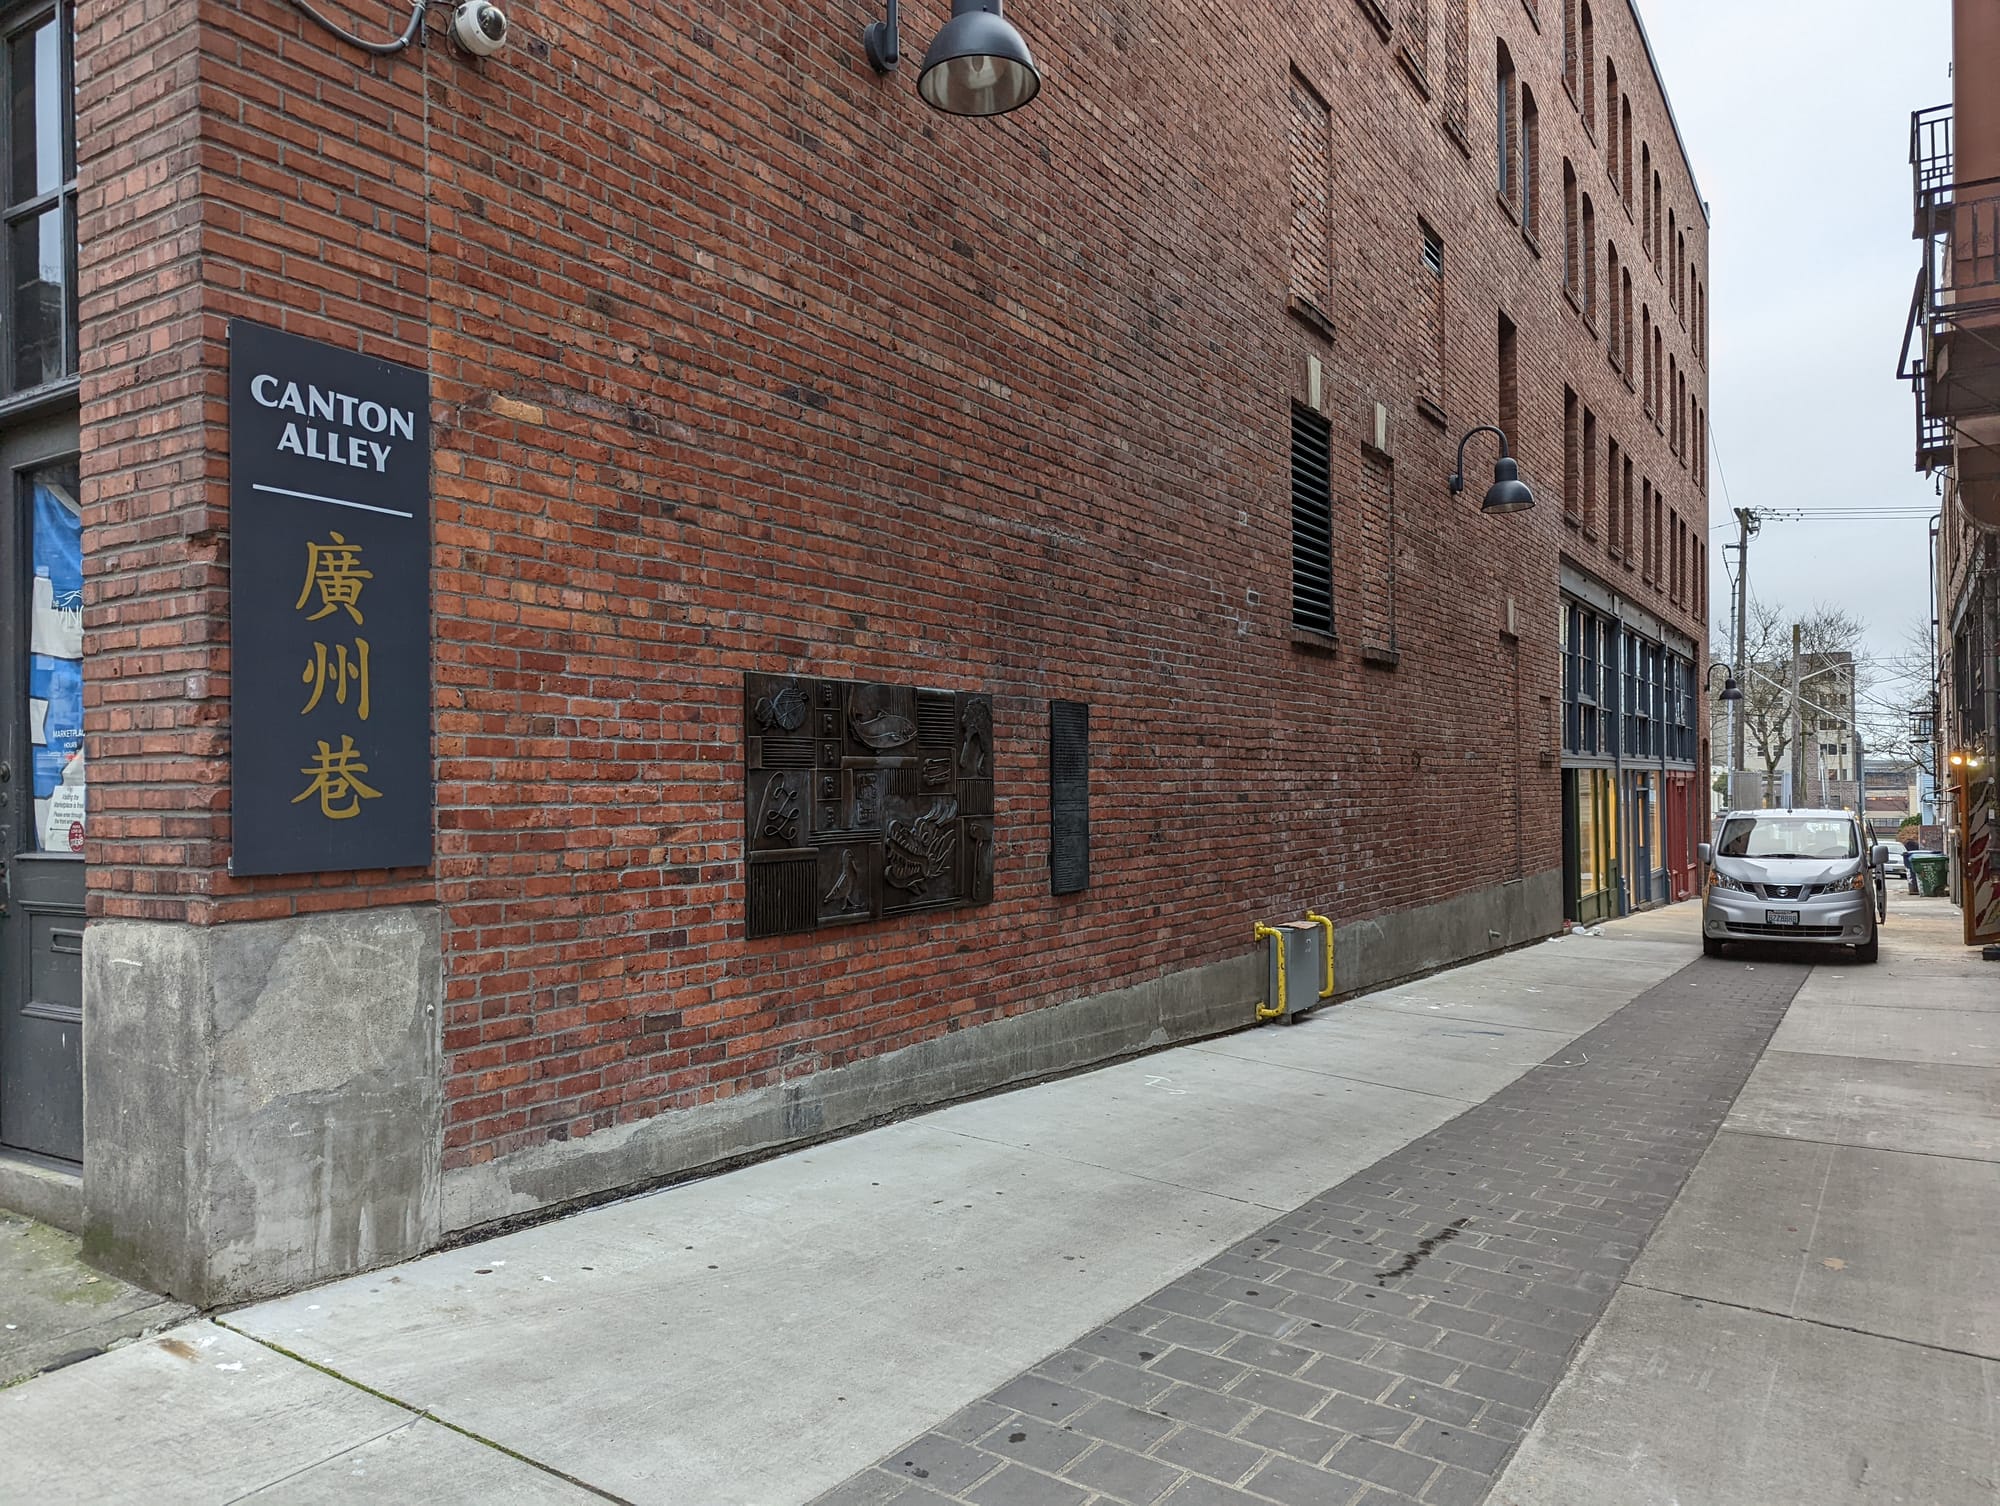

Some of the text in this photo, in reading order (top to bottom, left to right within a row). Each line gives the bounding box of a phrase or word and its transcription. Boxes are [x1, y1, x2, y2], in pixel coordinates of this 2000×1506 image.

[250, 374, 414, 441] CANTON
[276, 422, 392, 473] ALLEY
[291, 531, 383, 819] 廣州巷
